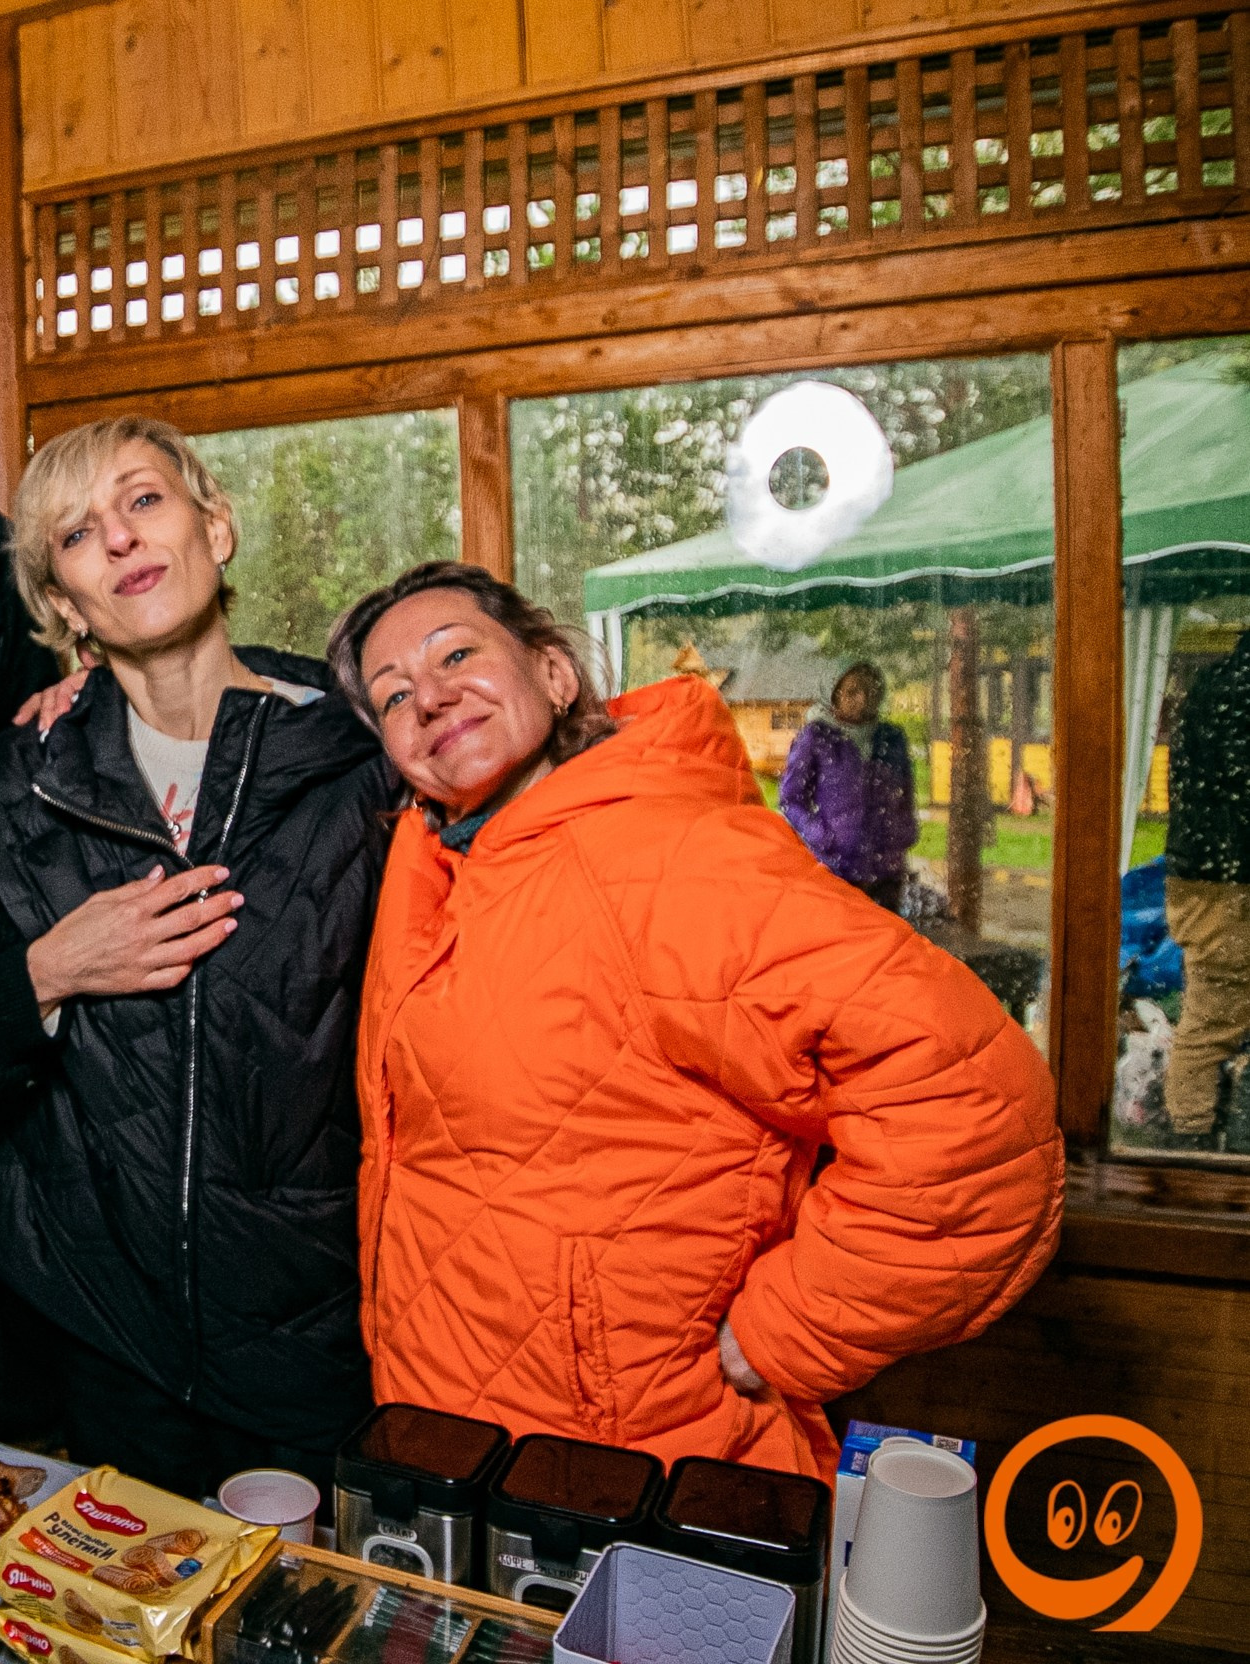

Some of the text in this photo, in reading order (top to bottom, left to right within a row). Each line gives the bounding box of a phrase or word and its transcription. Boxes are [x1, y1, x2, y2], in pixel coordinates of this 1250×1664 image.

[76, 1500, 144, 1532] Яшкино
[502, 1554, 591, 1583] КОФЕ РАСТВОРИ
